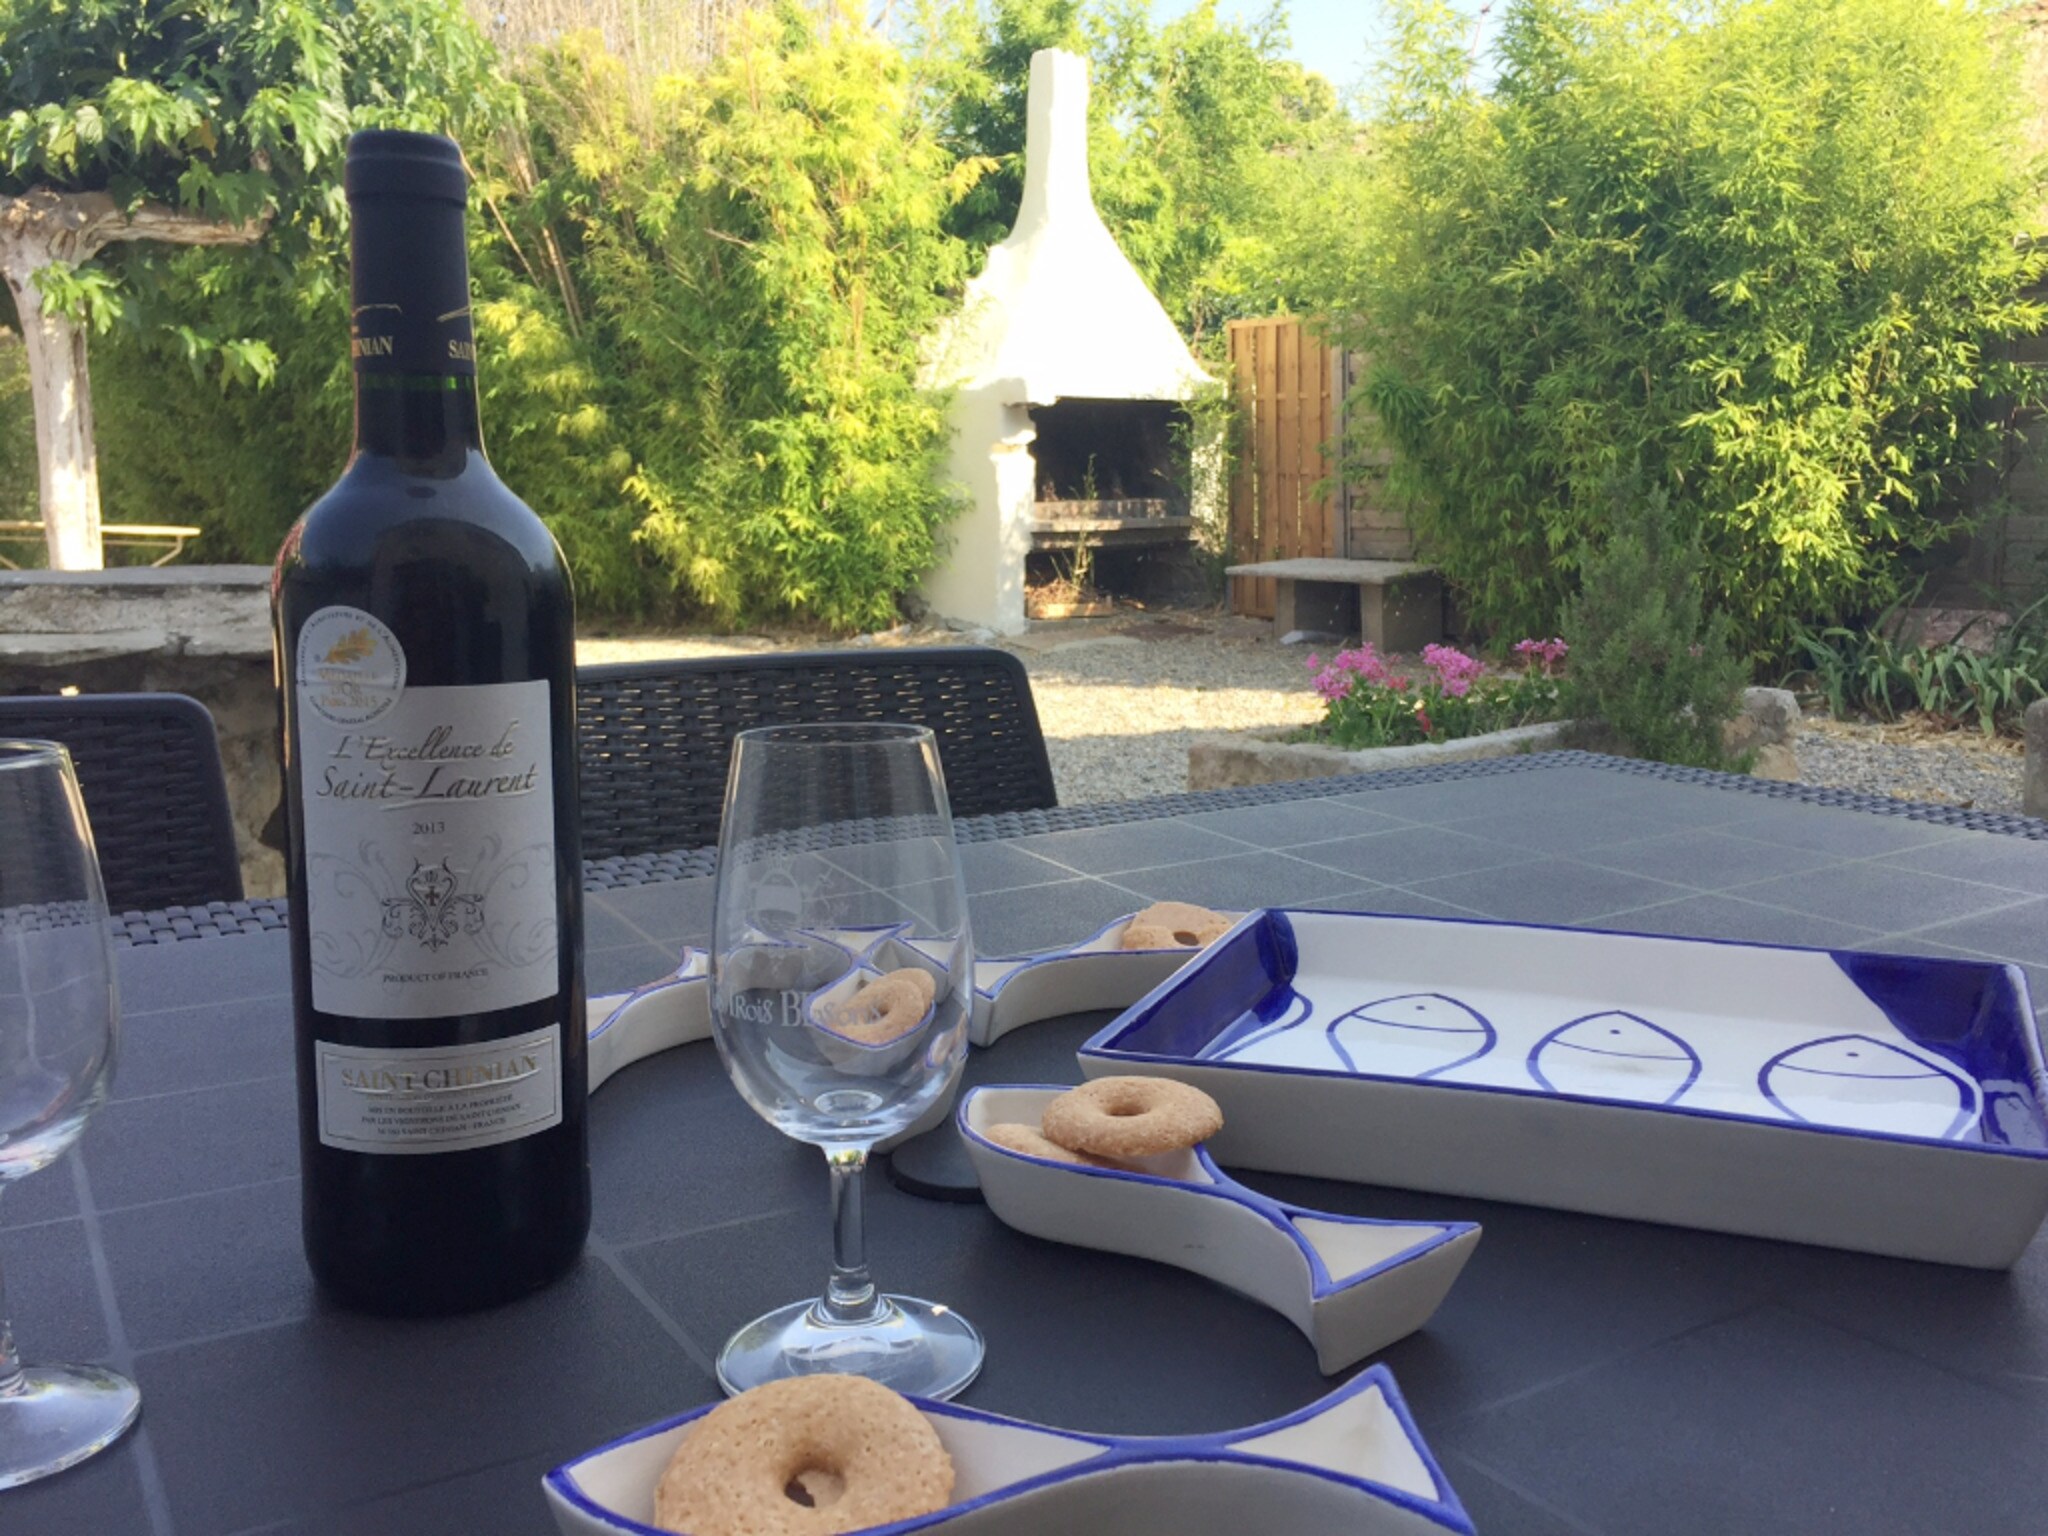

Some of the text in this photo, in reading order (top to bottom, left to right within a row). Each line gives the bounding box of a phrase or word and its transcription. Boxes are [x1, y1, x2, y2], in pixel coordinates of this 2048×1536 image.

[332, 720, 519, 771] L'Excellence de
[316, 763, 538, 800] Saint-Laurent
[412, 821, 445, 835] 2013
[383, 968, 489, 984] PRODUCT OF FRANCE
